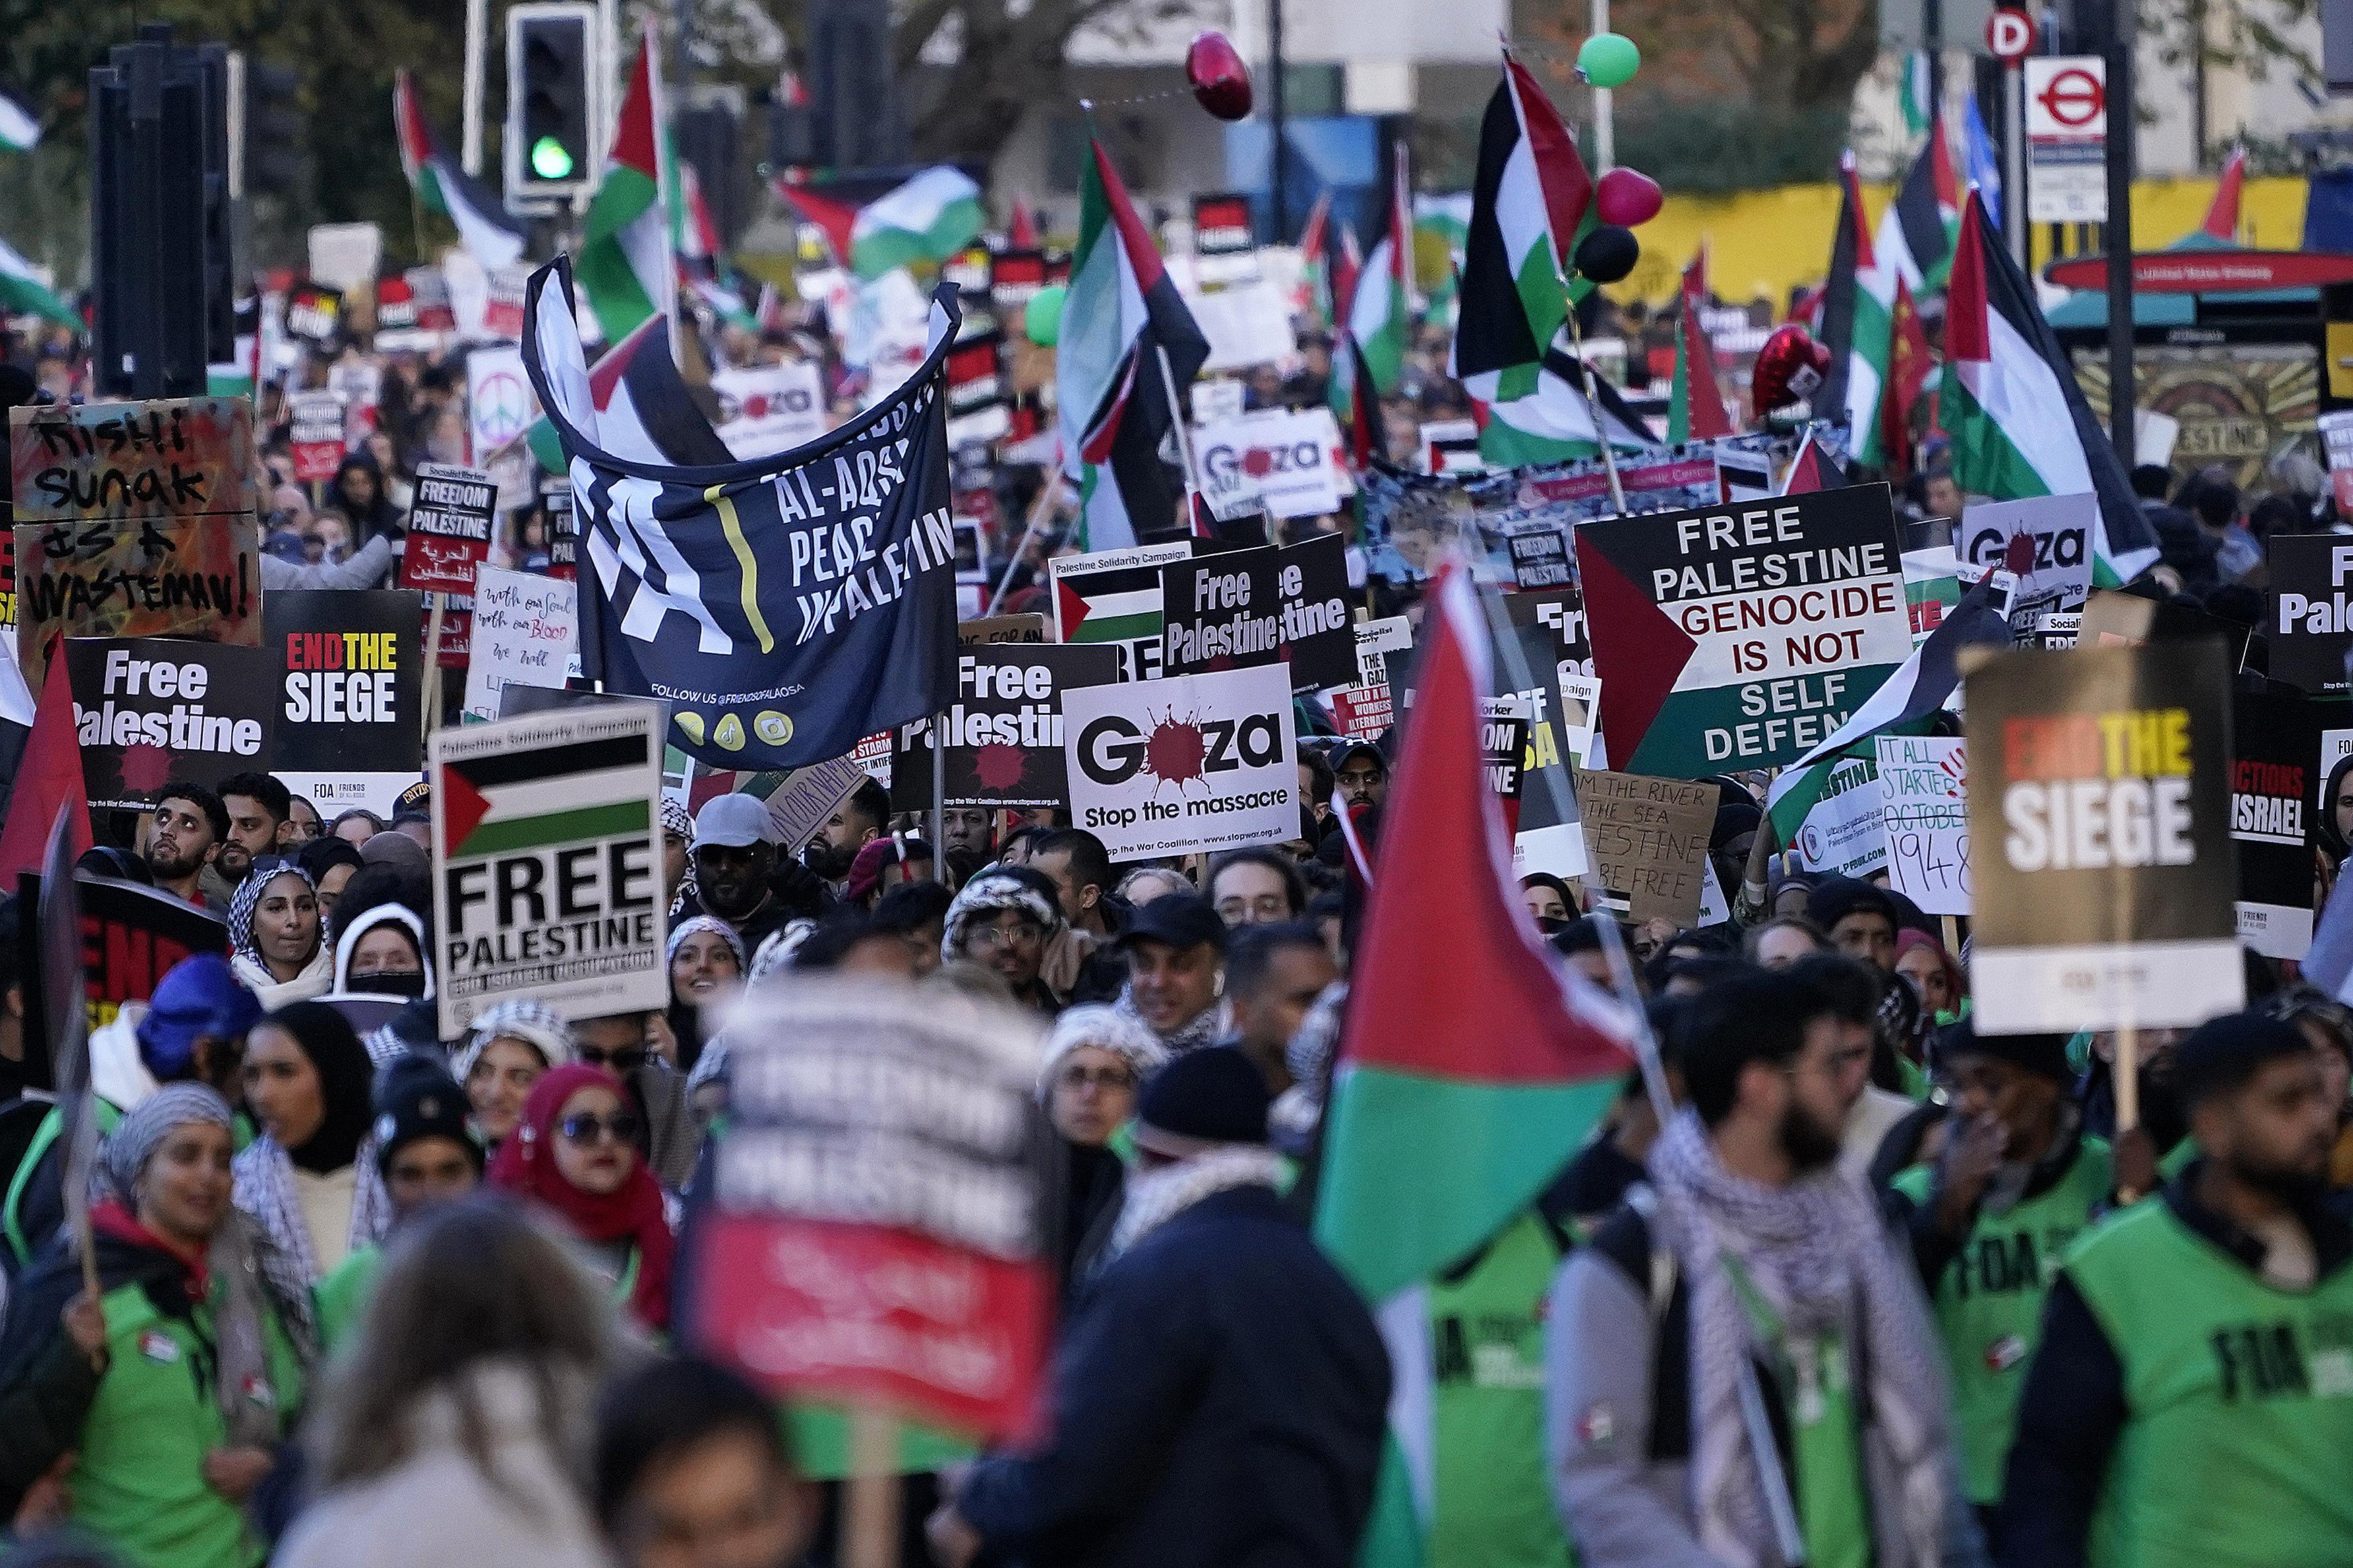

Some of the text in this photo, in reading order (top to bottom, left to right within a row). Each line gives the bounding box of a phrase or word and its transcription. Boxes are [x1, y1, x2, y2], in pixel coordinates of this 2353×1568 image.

[1992, 16, 2024, 51] D
[774, 438, 911, 524] AL-AQS
[1203, 441, 1321, 482] Gza
[419, 480, 489, 507] FREEDOM
[412, 509, 489, 539] PALESTINE
[1677, 506, 1804, 554] FREE
[789, 512, 880, 588] PEAC
[1056, 551, 1186, 574] Palestine Solidarity Campaign
[1969, 528, 2085, 571] Gza
[1195, 568, 1251, 613] Free
[1653, 542, 1889, 601] PALESTINE
[1680, 582, 1896, 636] GENOCIDE
[286, 632, 342, 670] END
[342, 632, 397, 670] THE
[1167, 610, 1277, 666] Palestine
[1354, 627, 1393, 640] Socialist
[1733, 629, 1866, 675] IS NOT
[104, 650, 208, 699] Free
[958, 656, 1052, 699] Free
[1362, 652, 1381, 670] THE
[285, 672, 397, 723] SIEGE
[651, 683, 702, 702] FOLLOW
[702, 693, 717, 704] US
[1346, 689, 1372, 705] BUILD
[1482, 701, 1513, 717] orker
[1562, 682, 1592, 697] paign
[1740, 674, 1847, 717] SELF
[1349, 712, 1395, 732] ALTERNATIVE
[1705, 711, 1850, 761] DEFEN
[2097, 706, 2195, 778] THE
[1077, 712, 1284, 786] Gza
[1878, 737, 1941, 765] IT ALL
[314, 784, 334, 798] FOA
[339, 783, 365, 792] FRIENDS
[1085, 788, 1289, 828] Stop the massacre
[1588, 799, 1669, 824] THE SEA
[1604, 777, 1639, 799] THE
[1648, 782, 1705, 806] RIVER
[2003, 776, 2195, 872] SIEGE
[2230, 793, 2306, 837] ISRAEL
[1120, 844, 1135, 853] the
[1136, 843, 1155, 851] War
[1157, 838, 1199, 850] Coalition
[1203, 826, 1283, 845] www.stopwar.org.uk
[1593, 823, 1706, 865] ESTINE
[445, 839, 653, 935] FREE
[1598, 863, 1625, 889] BE
[1630, 867, 1688, 900] FREE
[449, 912, 655, 974] PALESTINE
